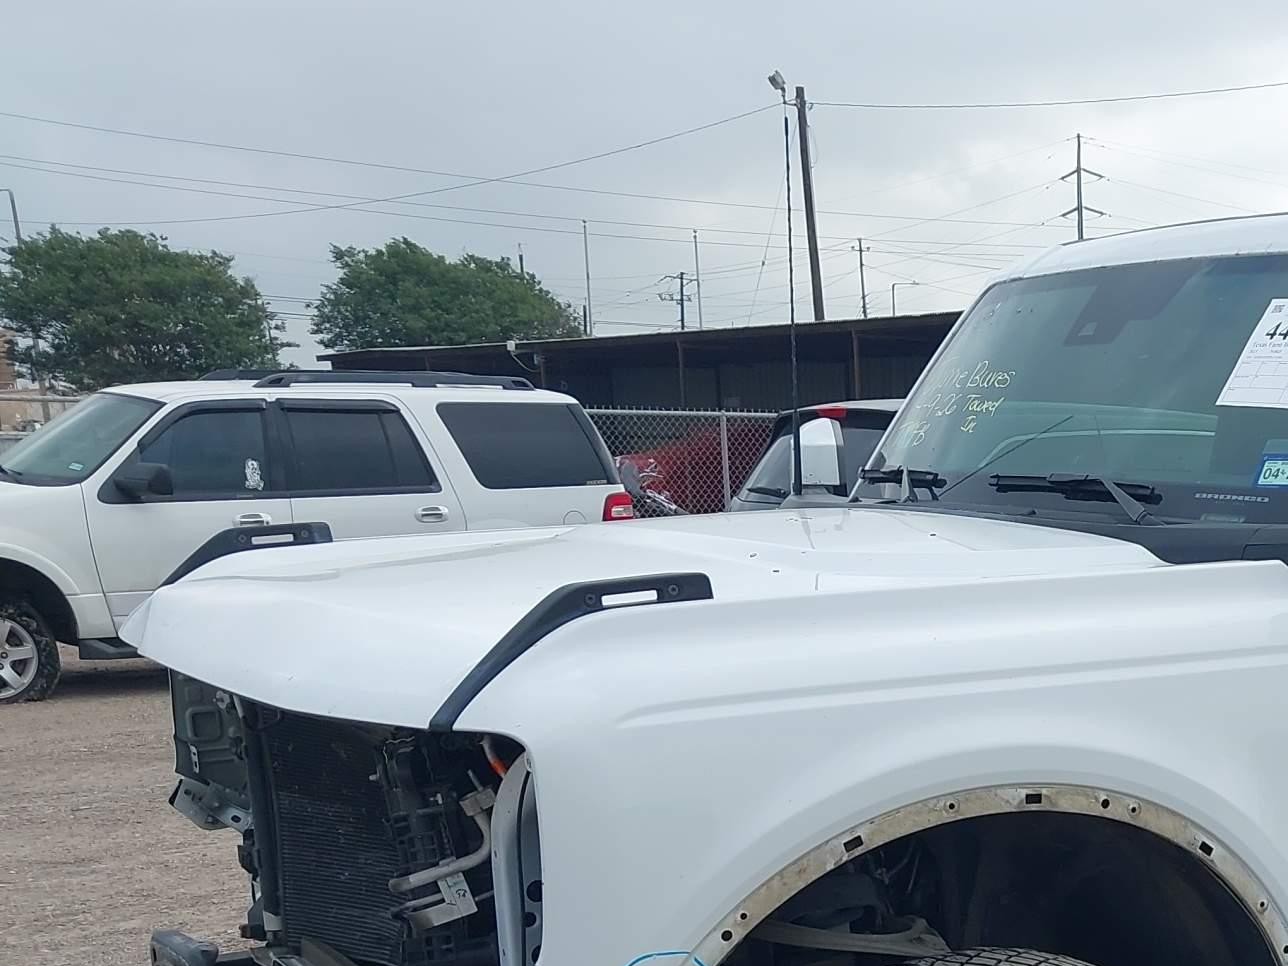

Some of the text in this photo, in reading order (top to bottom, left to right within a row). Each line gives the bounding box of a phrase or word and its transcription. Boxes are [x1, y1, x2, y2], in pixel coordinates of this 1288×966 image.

[962, 394, 1006, 416] Towed
[1263, 467, 1280, 480] 04
[1194, 492, 1270, 502] BRONCO
